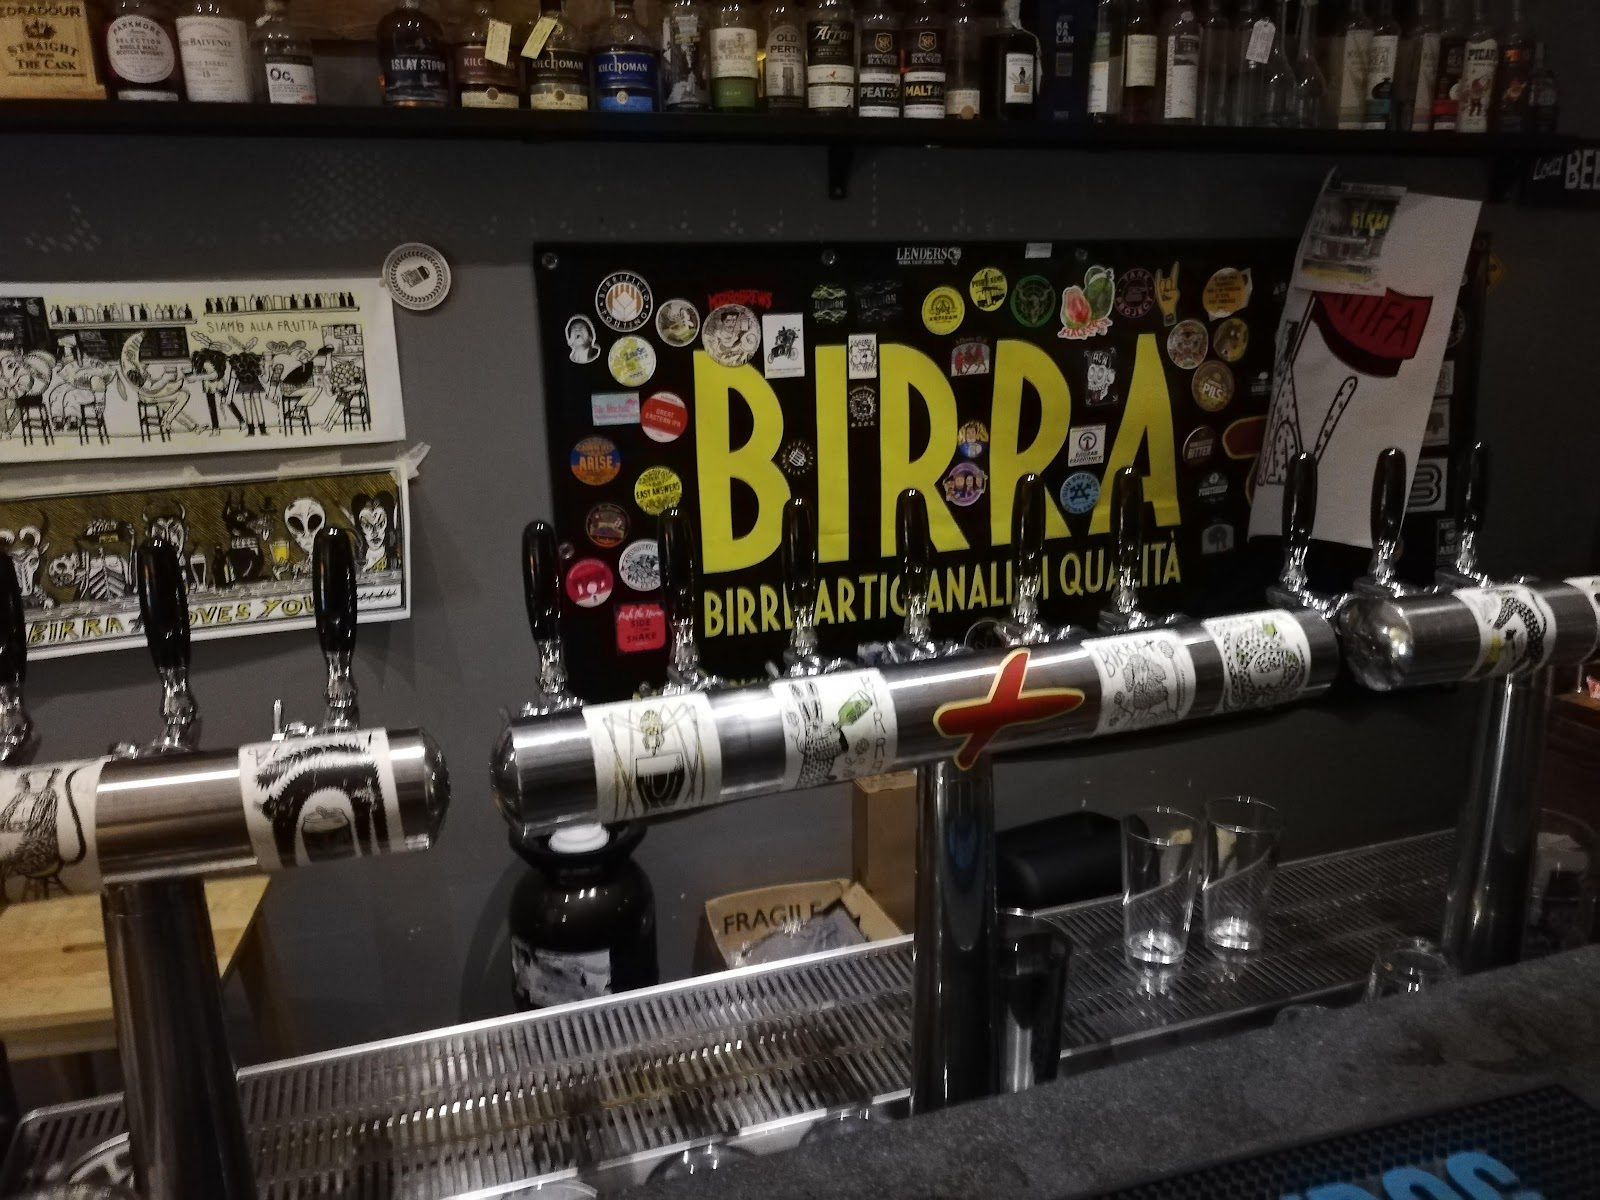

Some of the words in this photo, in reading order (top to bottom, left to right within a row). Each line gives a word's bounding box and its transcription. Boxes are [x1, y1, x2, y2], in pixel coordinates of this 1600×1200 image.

[113, 21, 161, 36] PARKMORE
[115, 37, 161, 45] SELECTION
[776, 34, 797, 42] OLD
[770, 45, 801, 53] PERTH
[44, 59, 77, 70] CASK
[391, 58, 417, 71] ISLAY
[1123, 271, 1150, 281] TANK
[1115, 296, 1153, 317] PROJECT
[207, 319, 245, 333] SIAMO
[250, 320, 273, 331] ALLA
[277, 319, 319, 331] FRUTTA
[1202, 382, 1223, 400] PILS
[655, 408, 675, 417] GREAT
[693, 333, 1182, 574] BIRRA
[579, 455, 613, 471] ARISE
[1072, 474, 1099, 492] BREWERY
[636, 488, 651, 500] EASY
[652, 481, 681, 496] ANSWERS
[1060, 531, 1182, 598] QUAITÀ
[188, 602, 252, 627] OVES
[631, 618, 650, 628] SIDE
[626, 631, 657, 643] SHAKE
